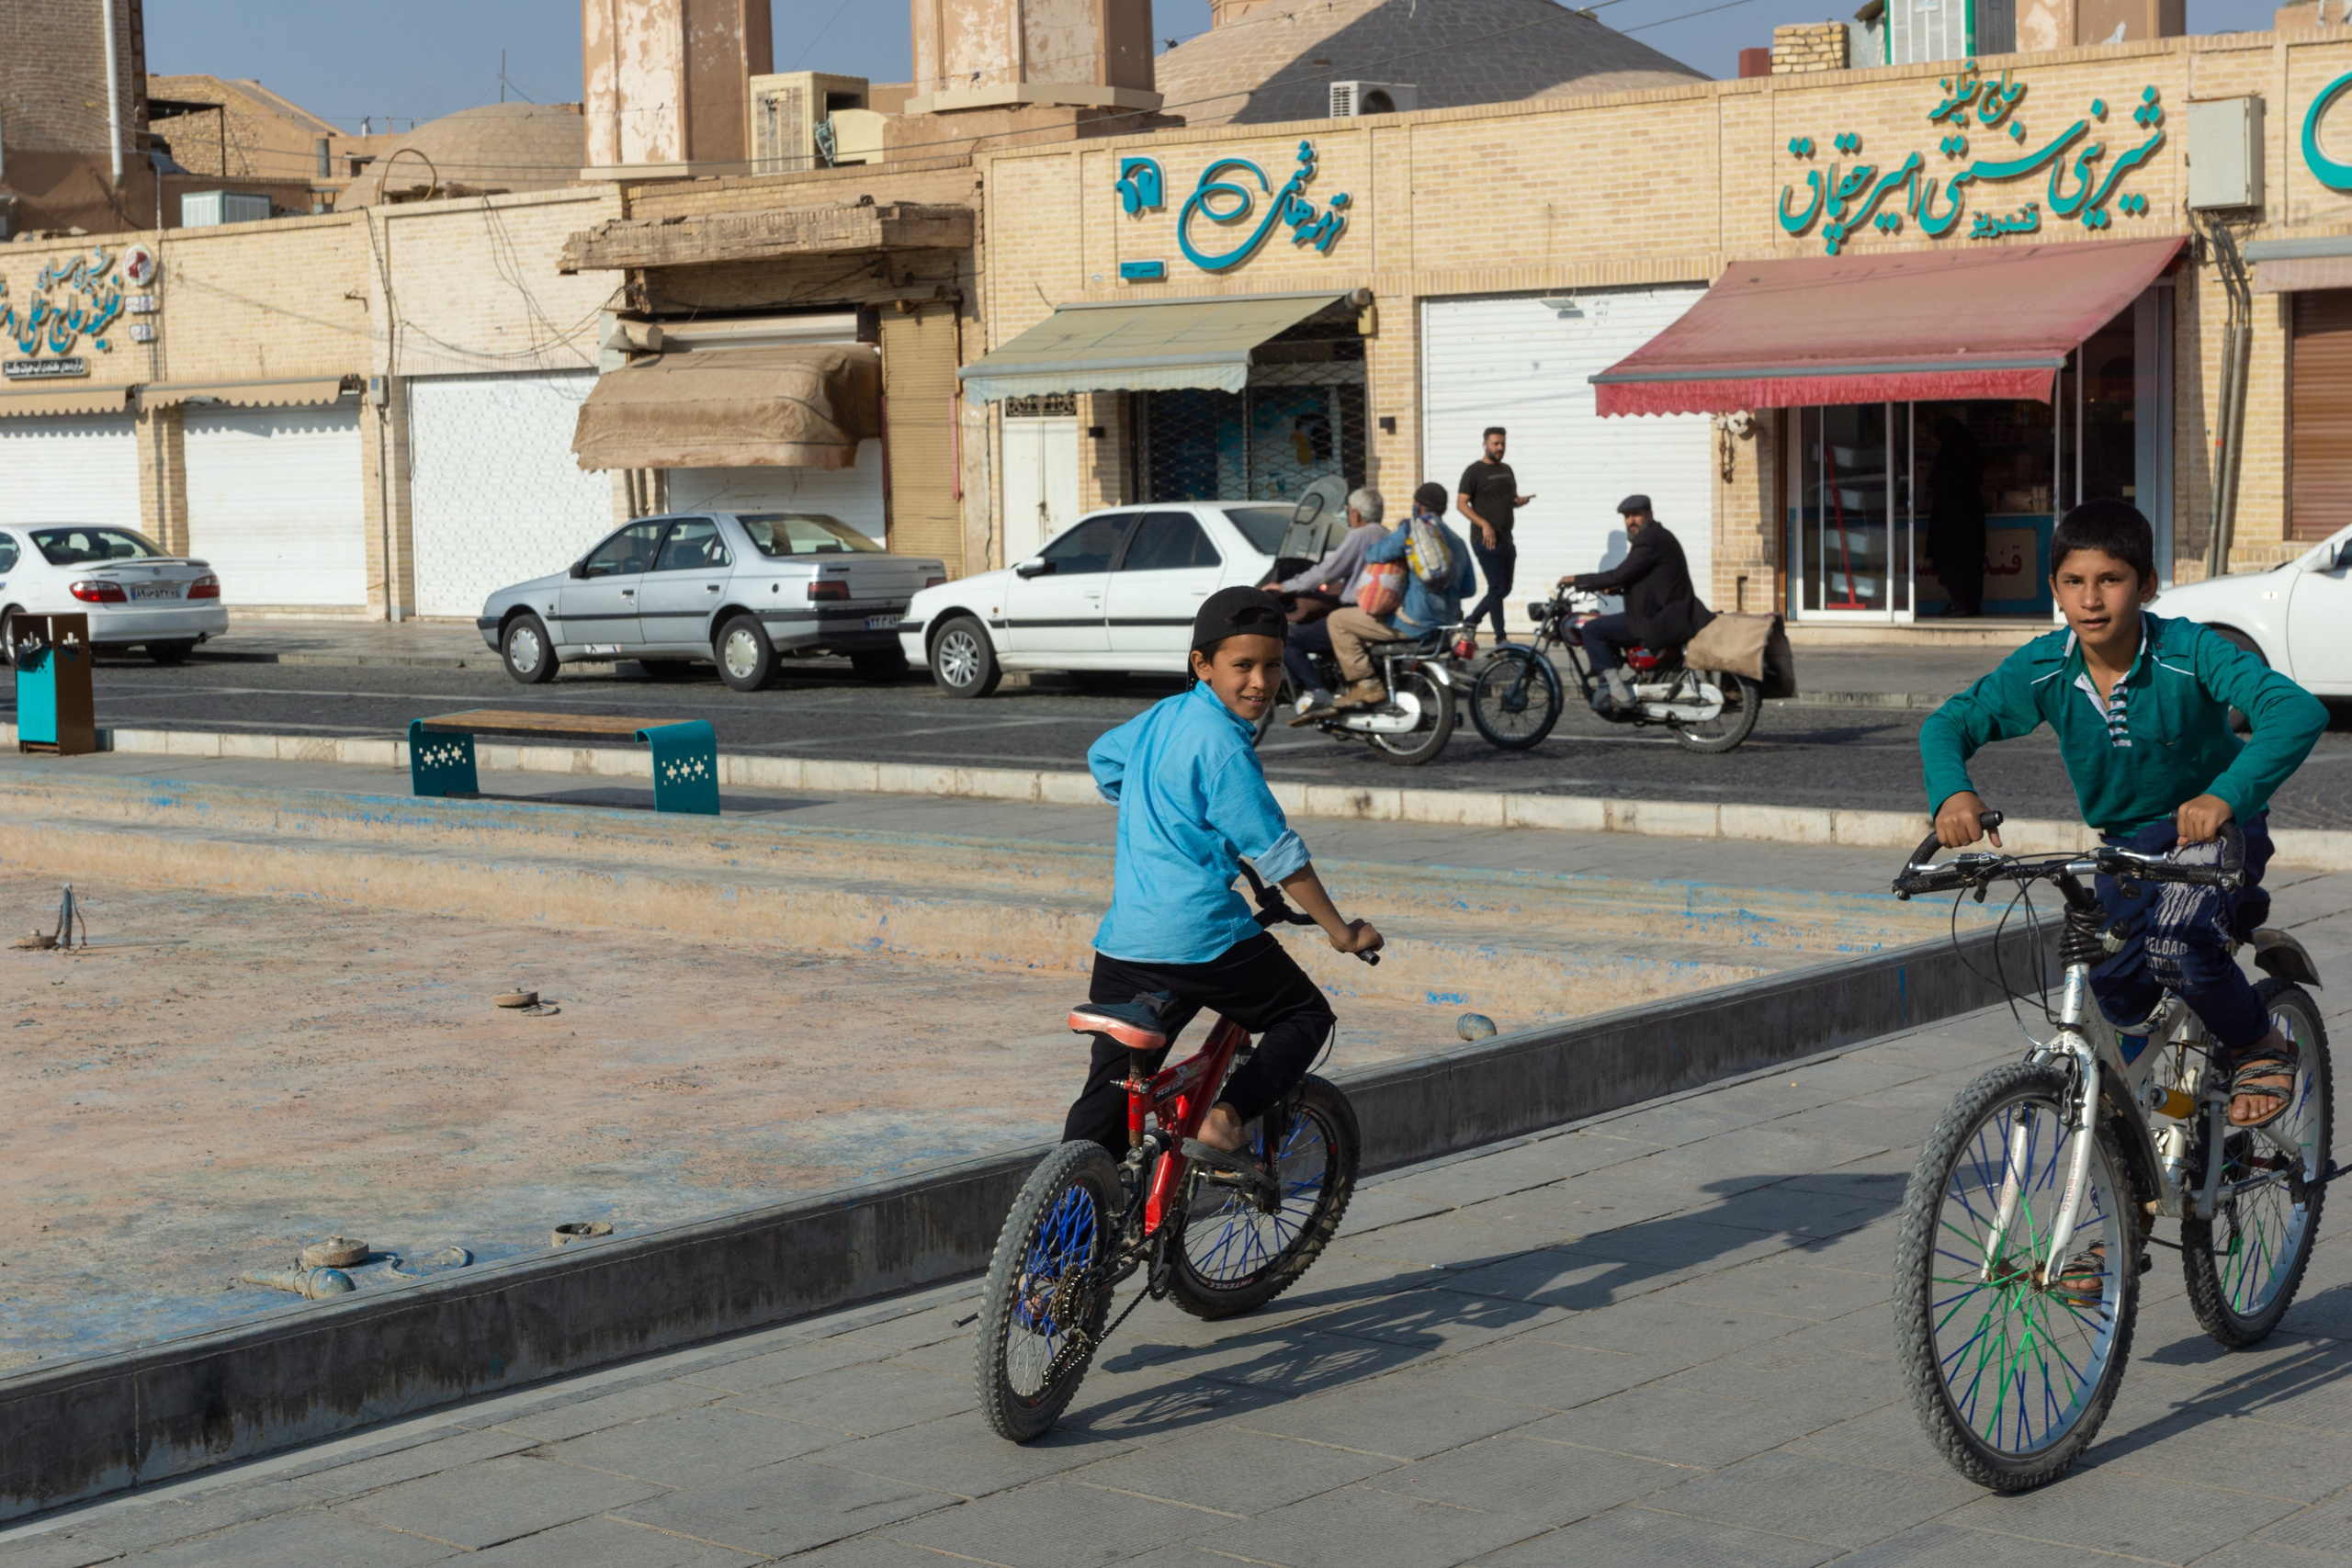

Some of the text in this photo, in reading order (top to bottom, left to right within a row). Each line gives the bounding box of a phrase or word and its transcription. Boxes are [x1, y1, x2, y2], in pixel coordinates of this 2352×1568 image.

[1928, 60, 2021, 124] حاج خلیفه
[1846, 151, 1919, 229] امیر
[1918, 120, 2086, 234] سنتی
[2049, 85, 2164, 228] شیرینی
